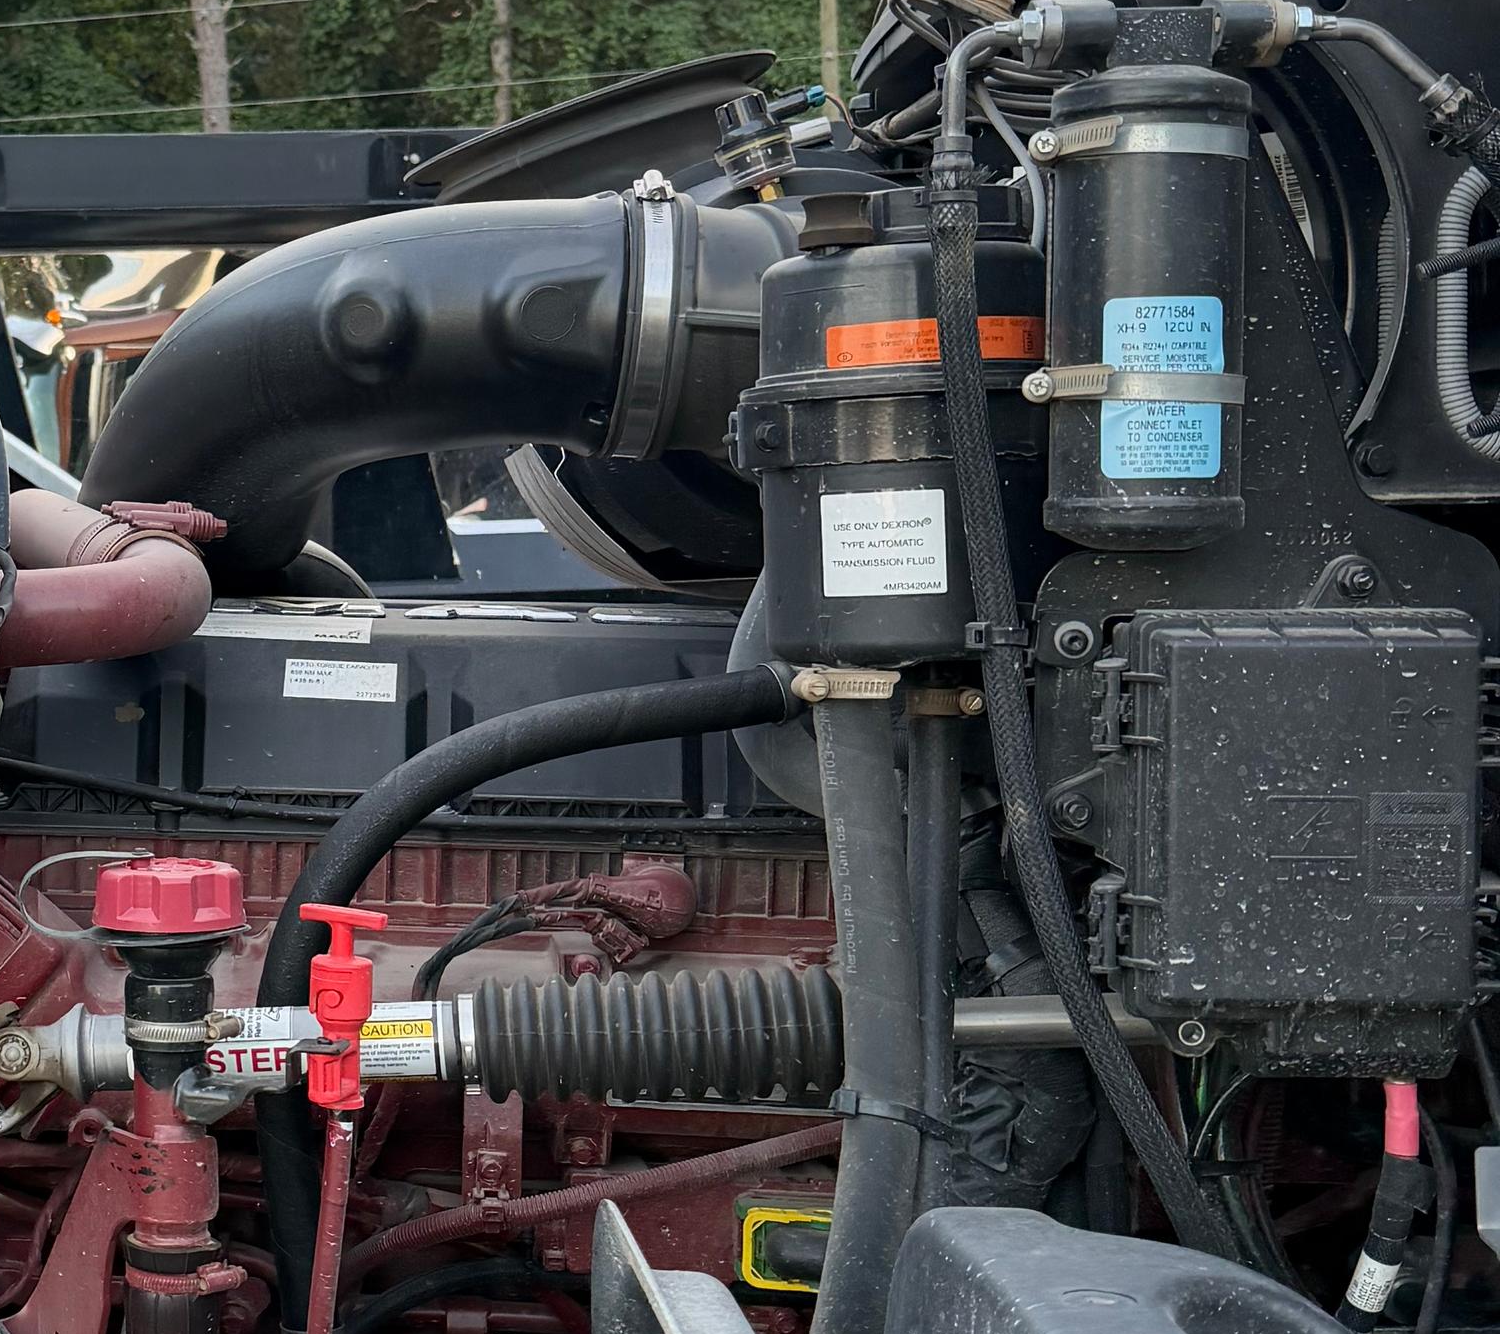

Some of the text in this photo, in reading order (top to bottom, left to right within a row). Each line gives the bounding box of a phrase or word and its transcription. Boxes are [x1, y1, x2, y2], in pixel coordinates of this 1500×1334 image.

[1135, 306, 1195, 319] 82771584
[1165, 322, 1193, 332] 12CU
[1200, 322, 1211, 332] IN
[1122, 353, 1208, 363] SERVICE MOISTURE
[1167, 364, 1183, 372] PER
[1187, 364, 1212, 372] COLOR
[1146, 406, 1186, 416] WAFER
[1127, 420, 1202, 430] CONNECT INLET
[1128, 433, 1203, 442] TO CONDENSER
[833, 523, 851, 532] USE
[854, 522, 879, 531] ONLY
[841, 538, 924, 549] TYPE AUTOMATIC
[832, 556, 936, 568] TRANSMISSION FLUID
[883, 581, 941, 590] 4MR3420AM
[360, 1024, 424, 1037] CAUTION
